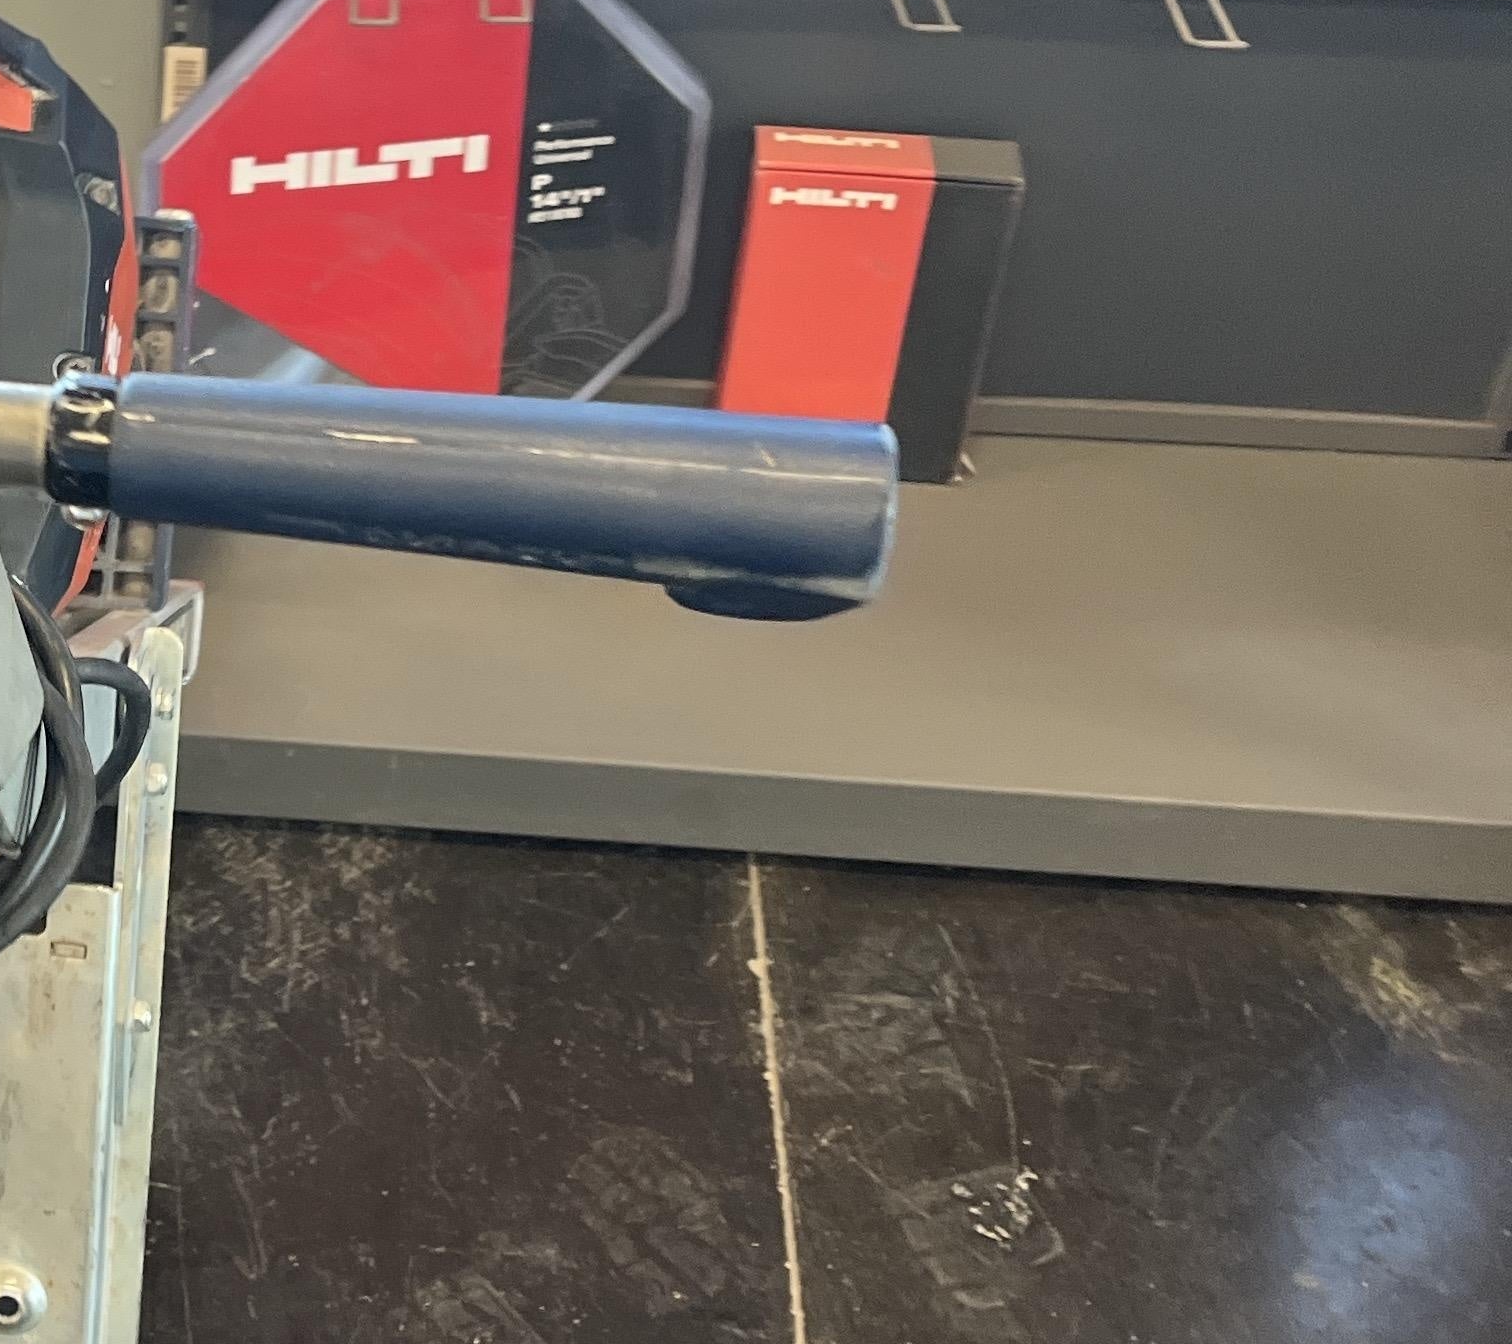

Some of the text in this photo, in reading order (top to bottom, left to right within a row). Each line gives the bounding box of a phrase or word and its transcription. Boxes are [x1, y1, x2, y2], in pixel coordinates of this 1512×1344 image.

[230, 133, 490, 196] HILTI
[530, 173, 553, 191] P
[769, 186, 899, 212] HILTI
